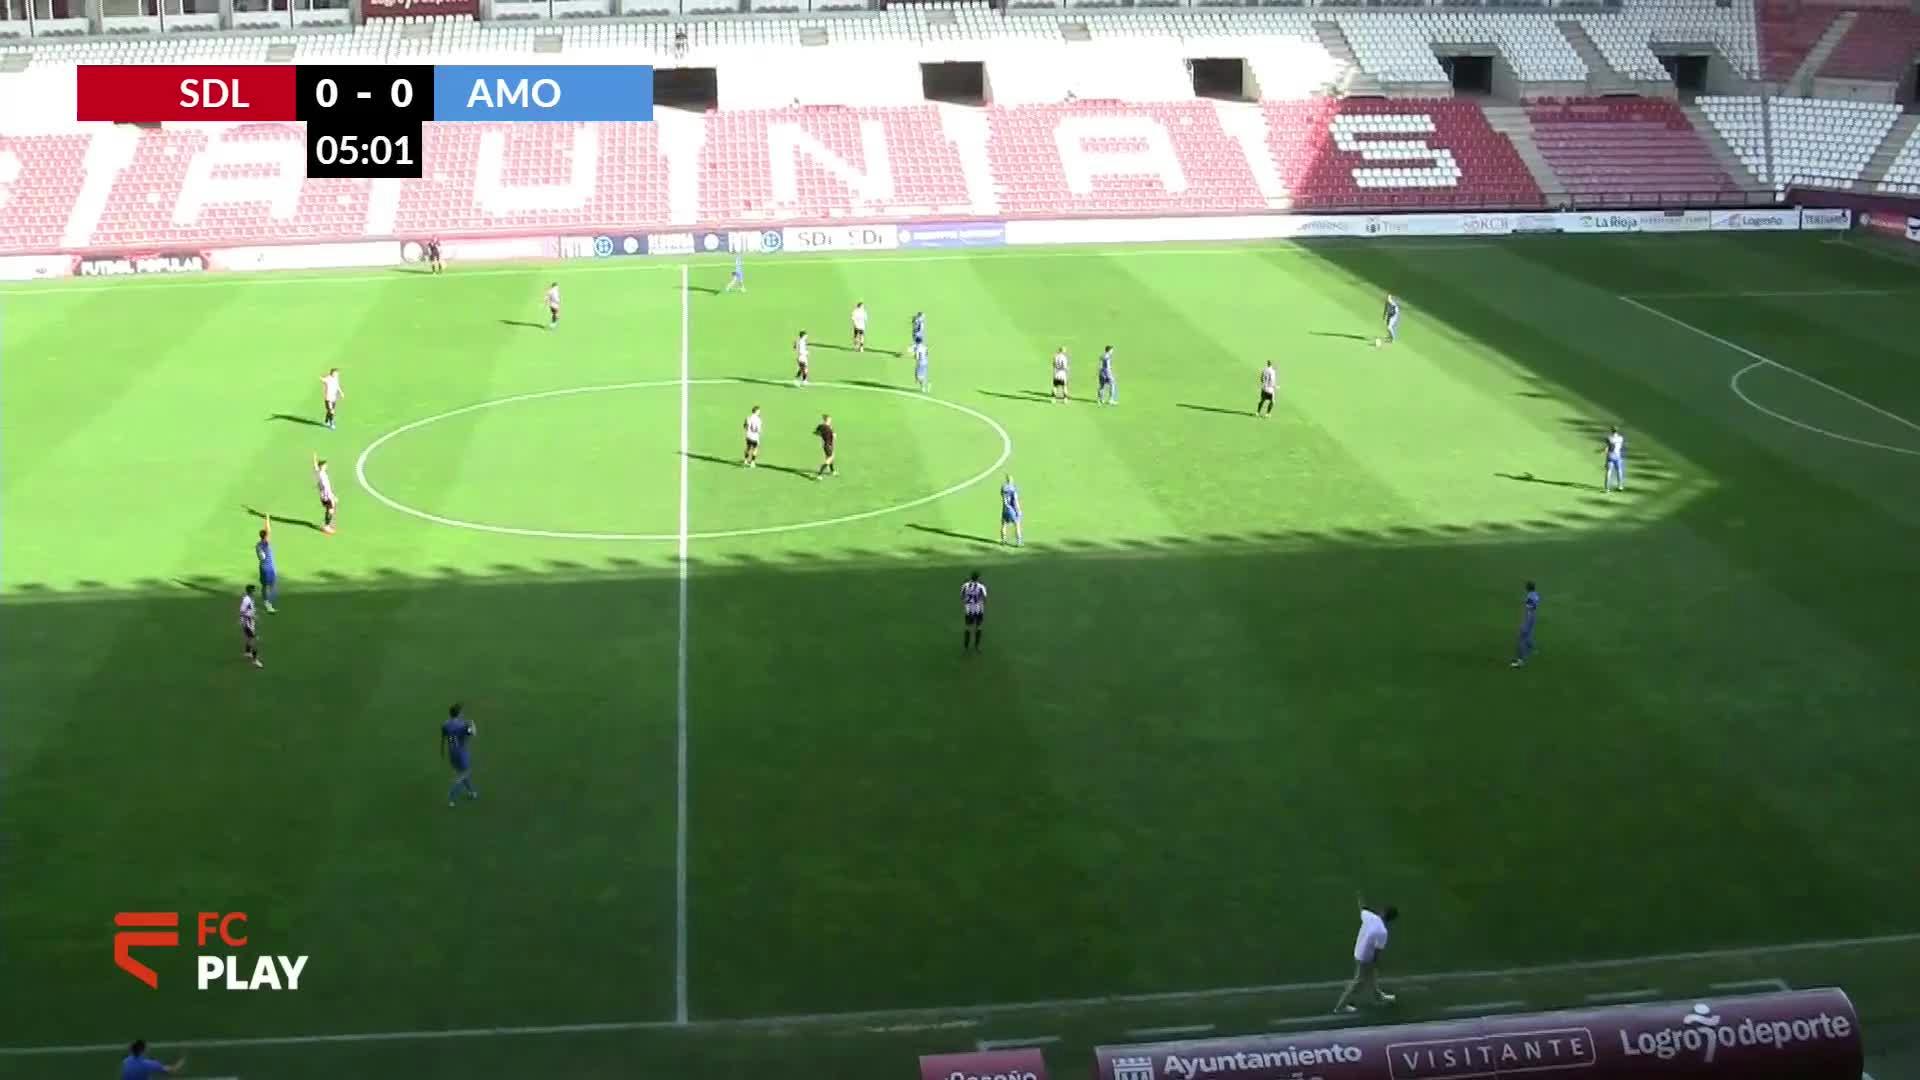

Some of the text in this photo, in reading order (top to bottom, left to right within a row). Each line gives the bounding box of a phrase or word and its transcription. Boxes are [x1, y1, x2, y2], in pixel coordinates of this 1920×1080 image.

[1610, 215, 1638, 230] Rioja
[136, 256, 203, 273] POPULAR
[1164, 1043, 1363, 1079] Ayuntamiento
[1402, 1037, 1585, 1072] VISITANTE
